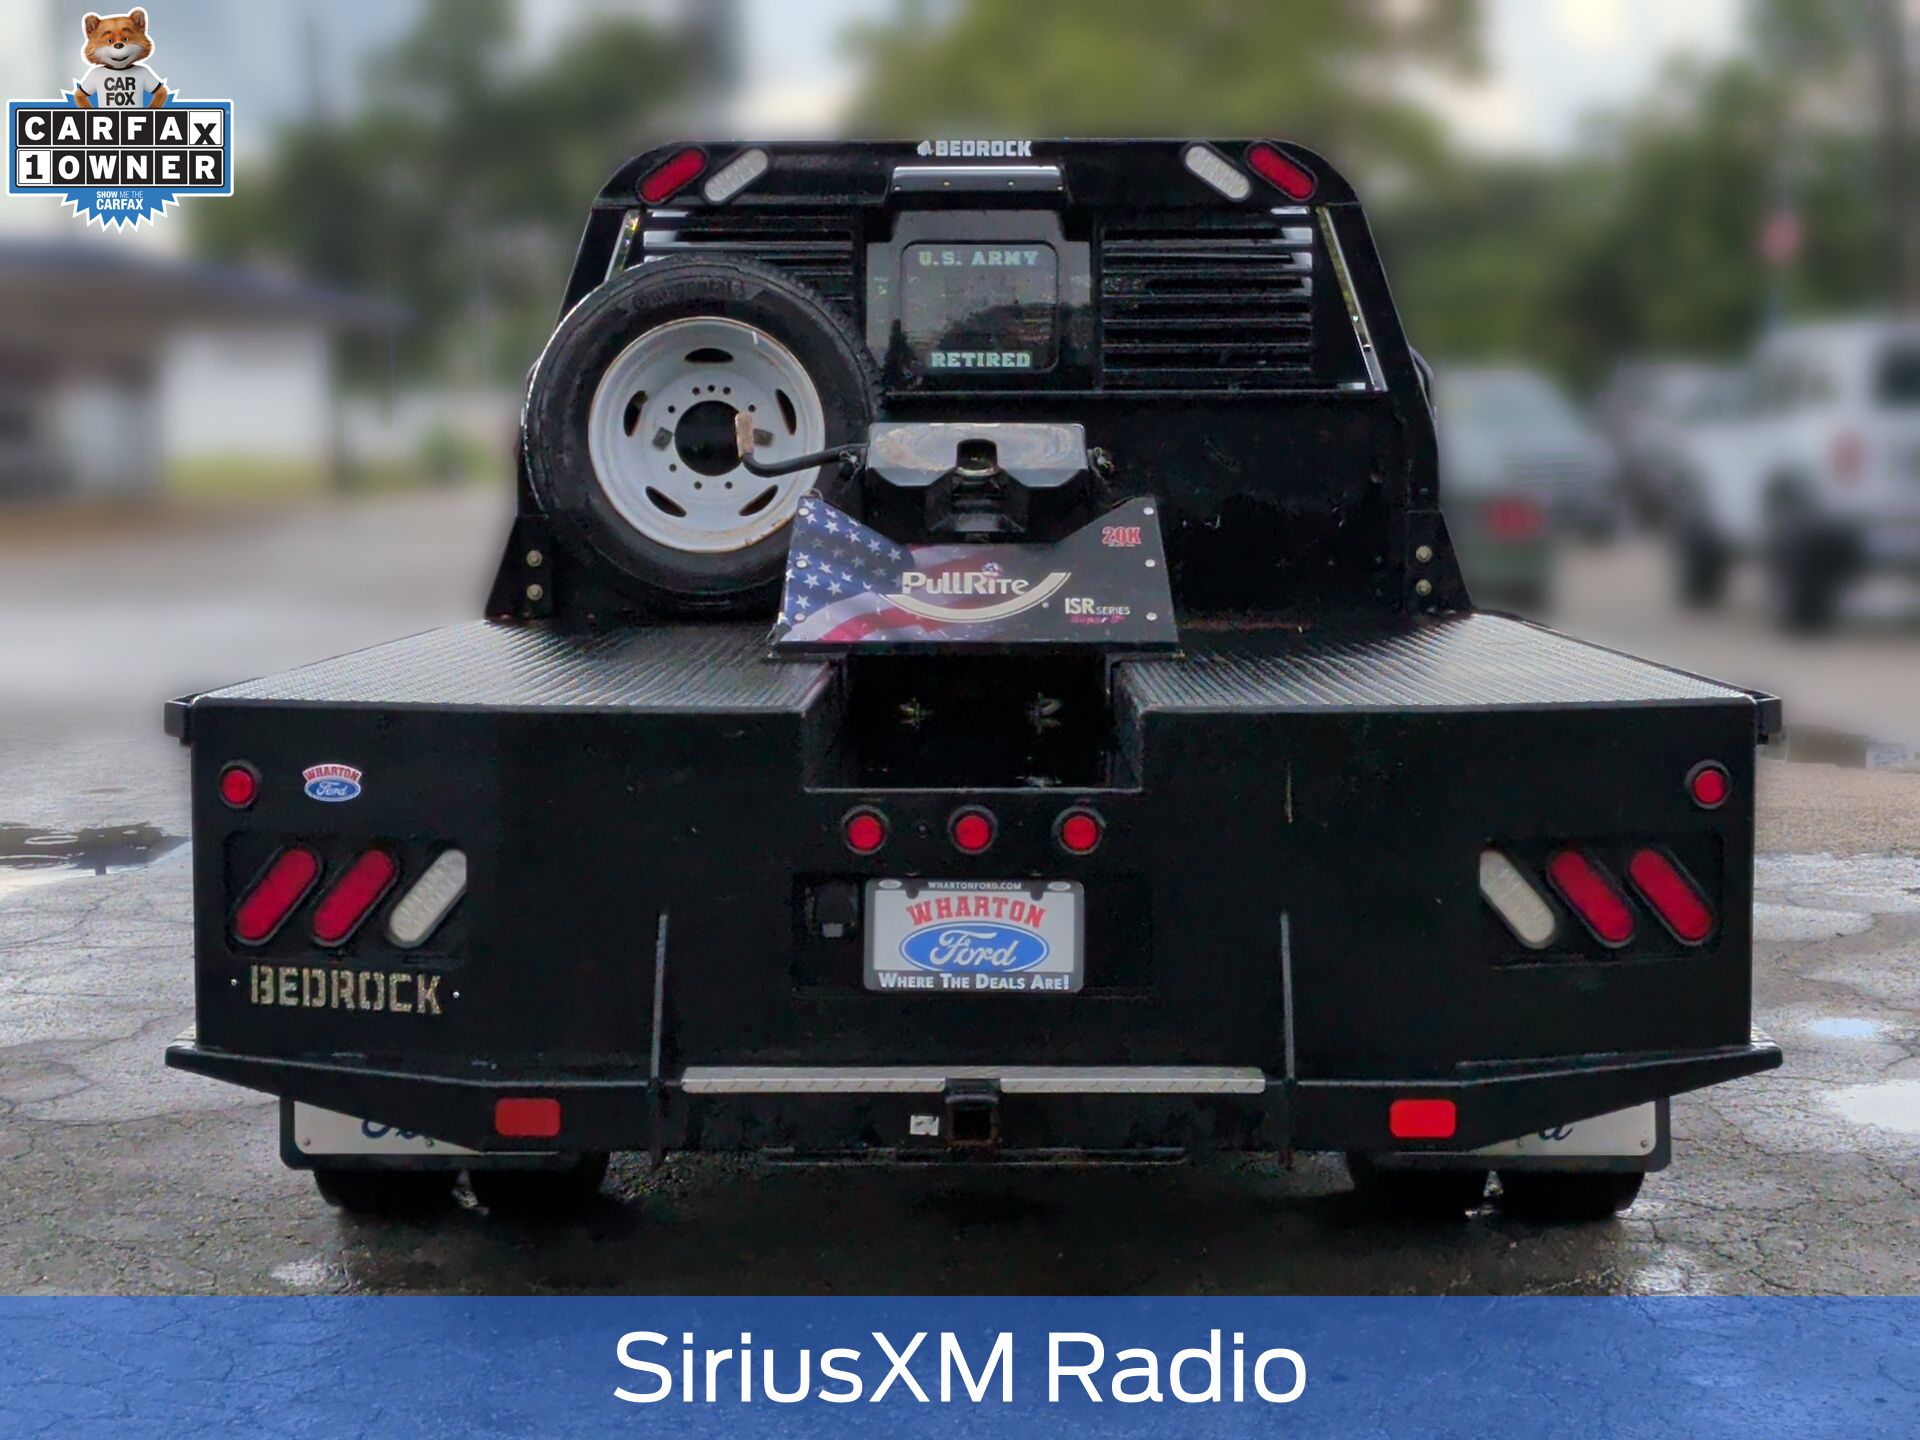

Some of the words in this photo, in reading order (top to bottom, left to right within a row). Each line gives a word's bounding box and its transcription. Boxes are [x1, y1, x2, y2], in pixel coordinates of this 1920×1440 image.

[935, 140, 1032, 157] BEDROCK
[918, 251, 963, 266] U.S.
[971, 251, 1039, 266] ARMY
[931, 352, 1032, 368] RETIRED
[1102, 526, 1142, 545] 20K
[1064, 597, 1095, 615] ISR
[1096, 606, 1131, 615] SERIES
[303, 765, 361, 782] WHARTON
[315, 781, 348, 797] Ford
[928, 881, 1022, 890] WHARTONFORD.COM
[906, 895, 1046, 928] WHARTON
[929, 929, 1019, 966] Ford
[251, 964, 443, 1015] BEDROCK
